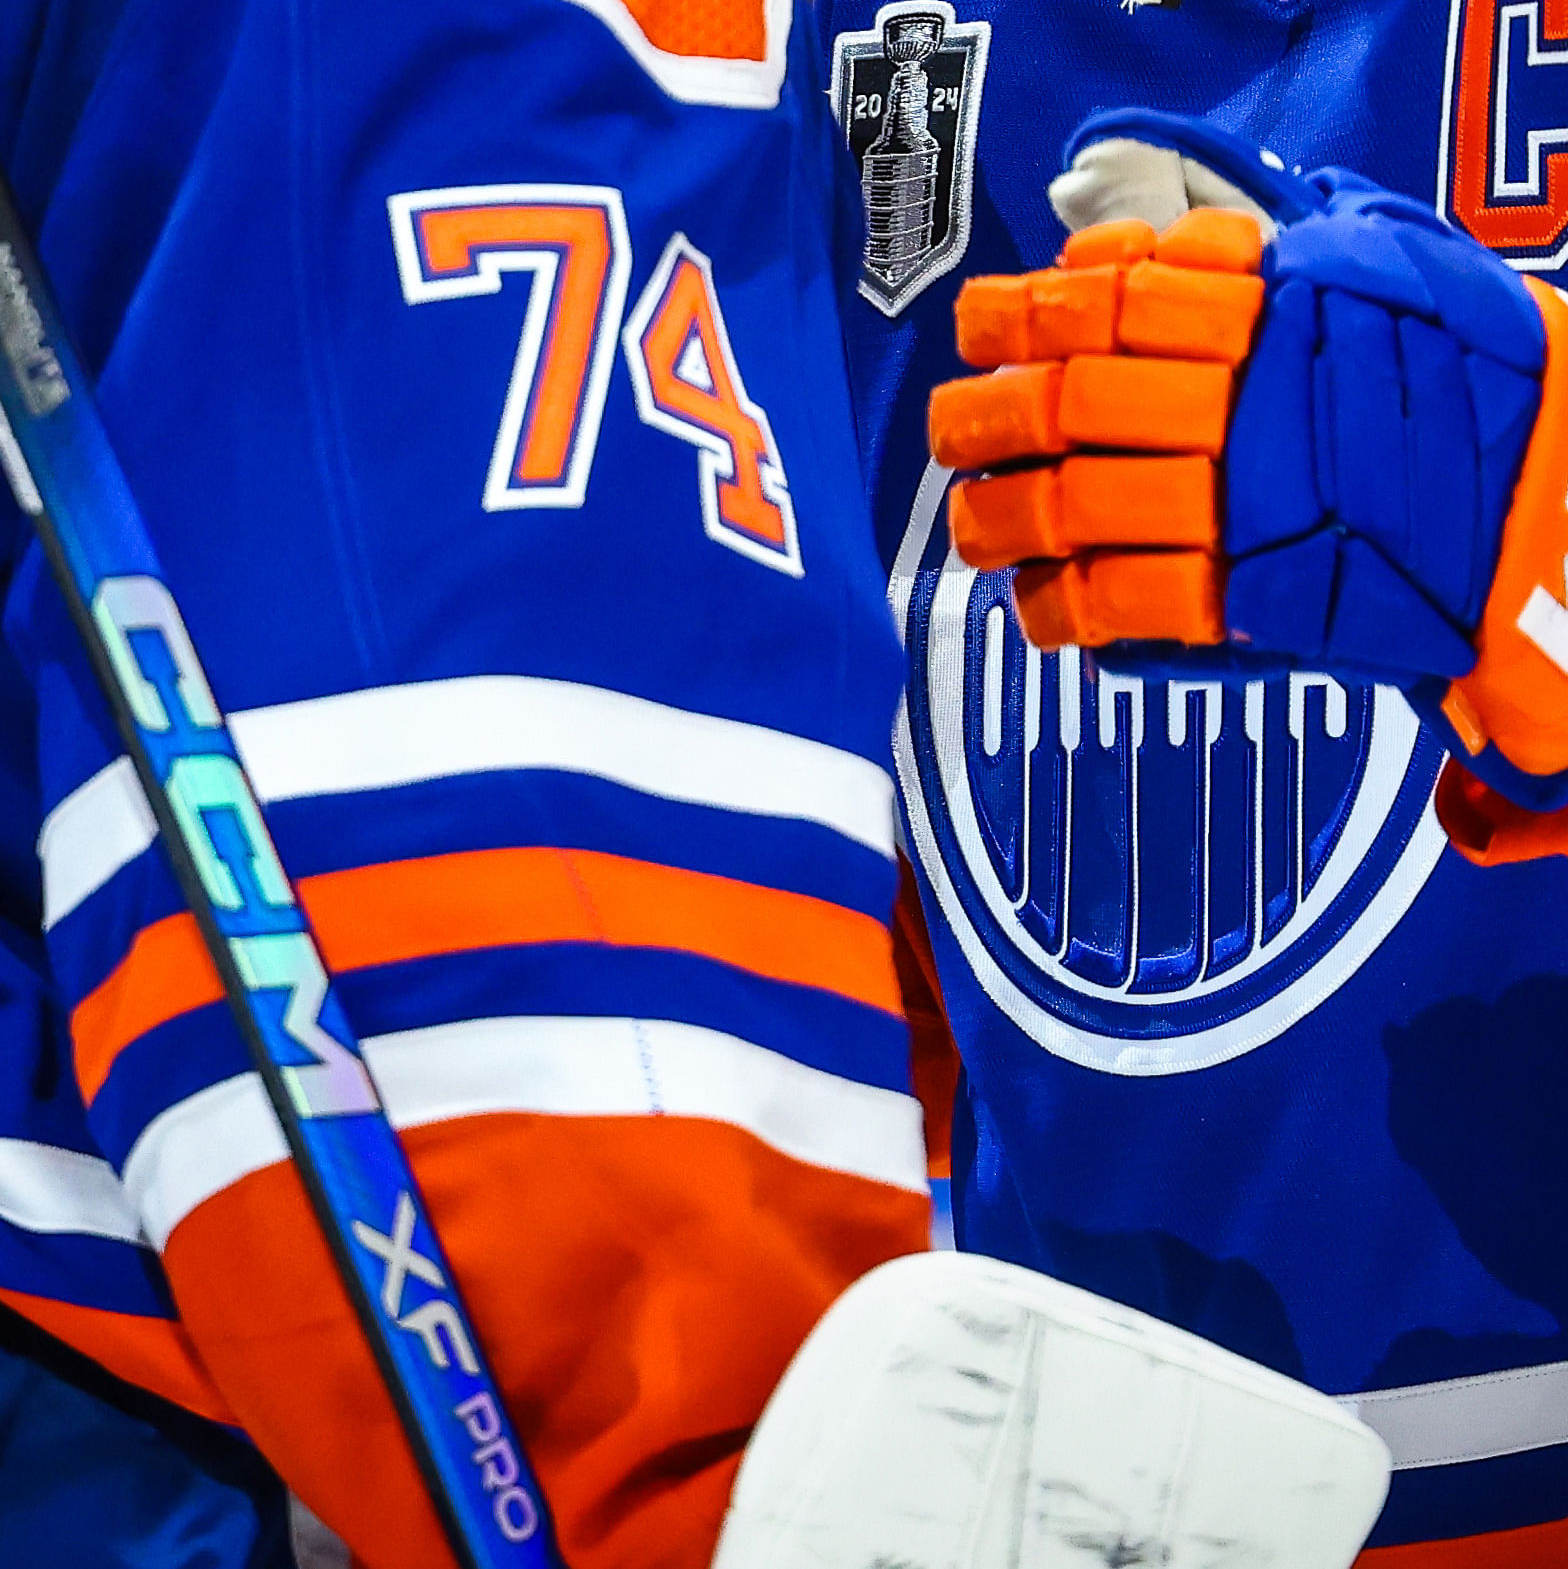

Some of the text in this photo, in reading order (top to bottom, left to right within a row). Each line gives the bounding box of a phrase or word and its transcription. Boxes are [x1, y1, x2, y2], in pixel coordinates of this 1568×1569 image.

[854, 86, 959, 120] 20 24
[386, 182, 806, 579] 74
[92, 574, 539, 1543] CCM XF PRO
